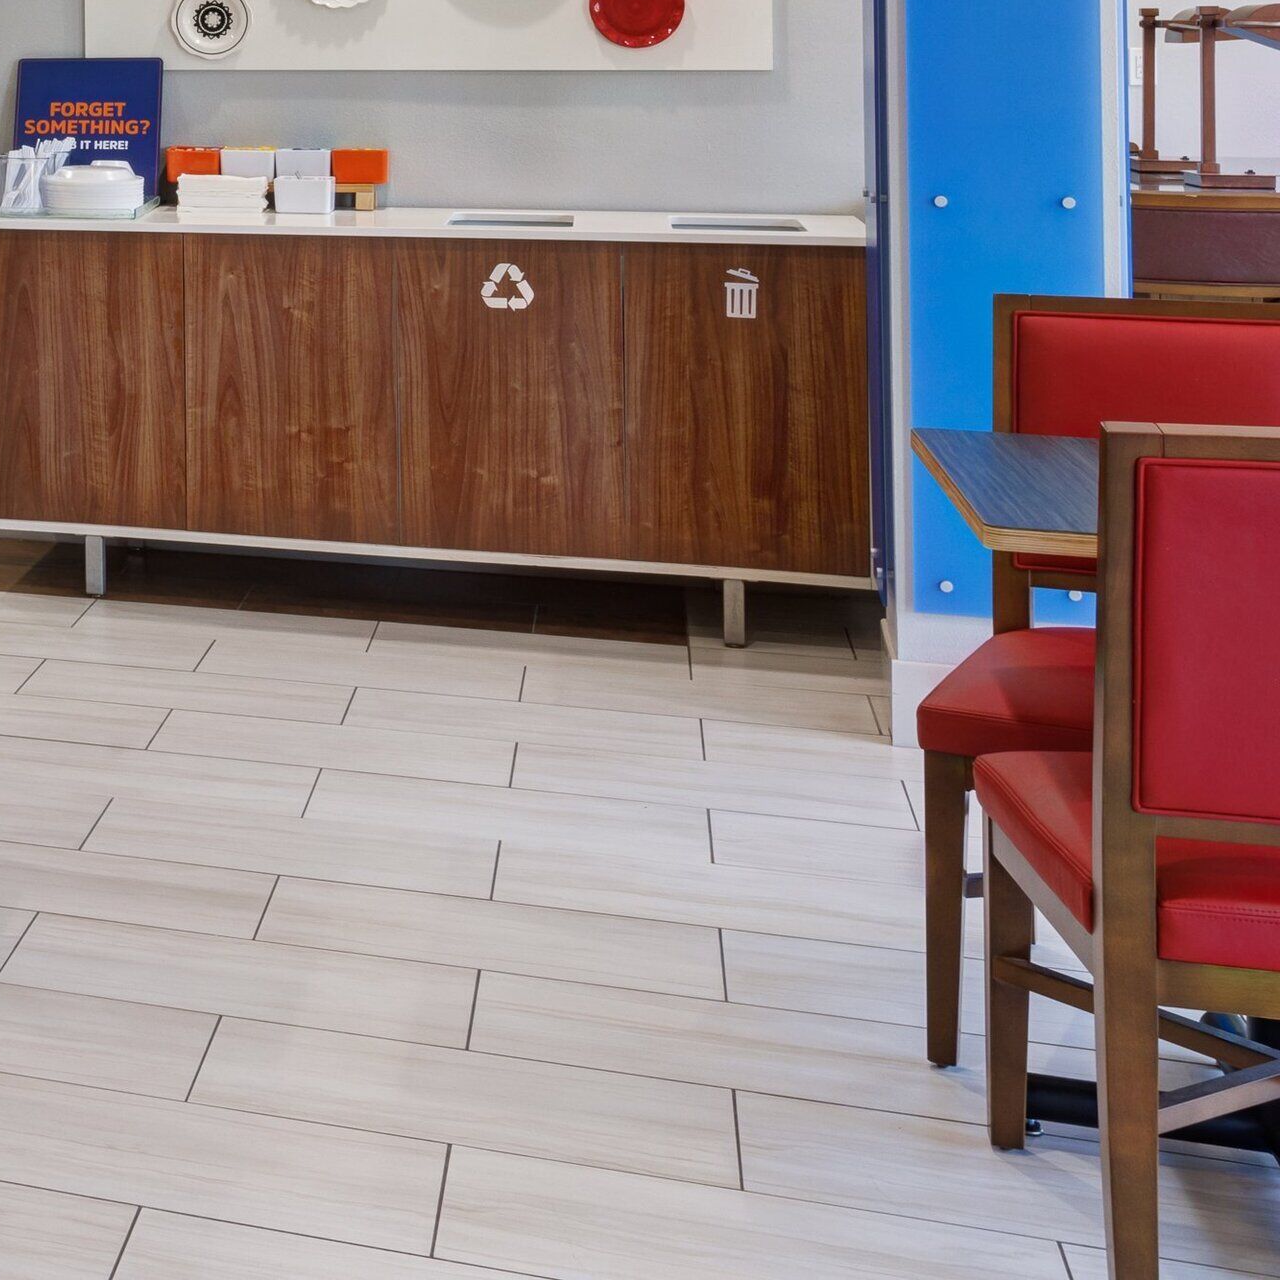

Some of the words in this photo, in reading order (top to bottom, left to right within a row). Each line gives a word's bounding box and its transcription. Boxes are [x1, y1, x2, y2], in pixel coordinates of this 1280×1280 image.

[50, 102, 126, 117] FORGET
[25, 120, 151, 135] SOMETHING?
[80, 141, 91, 150] IT
[94, 140, 129, 150] HERE!
